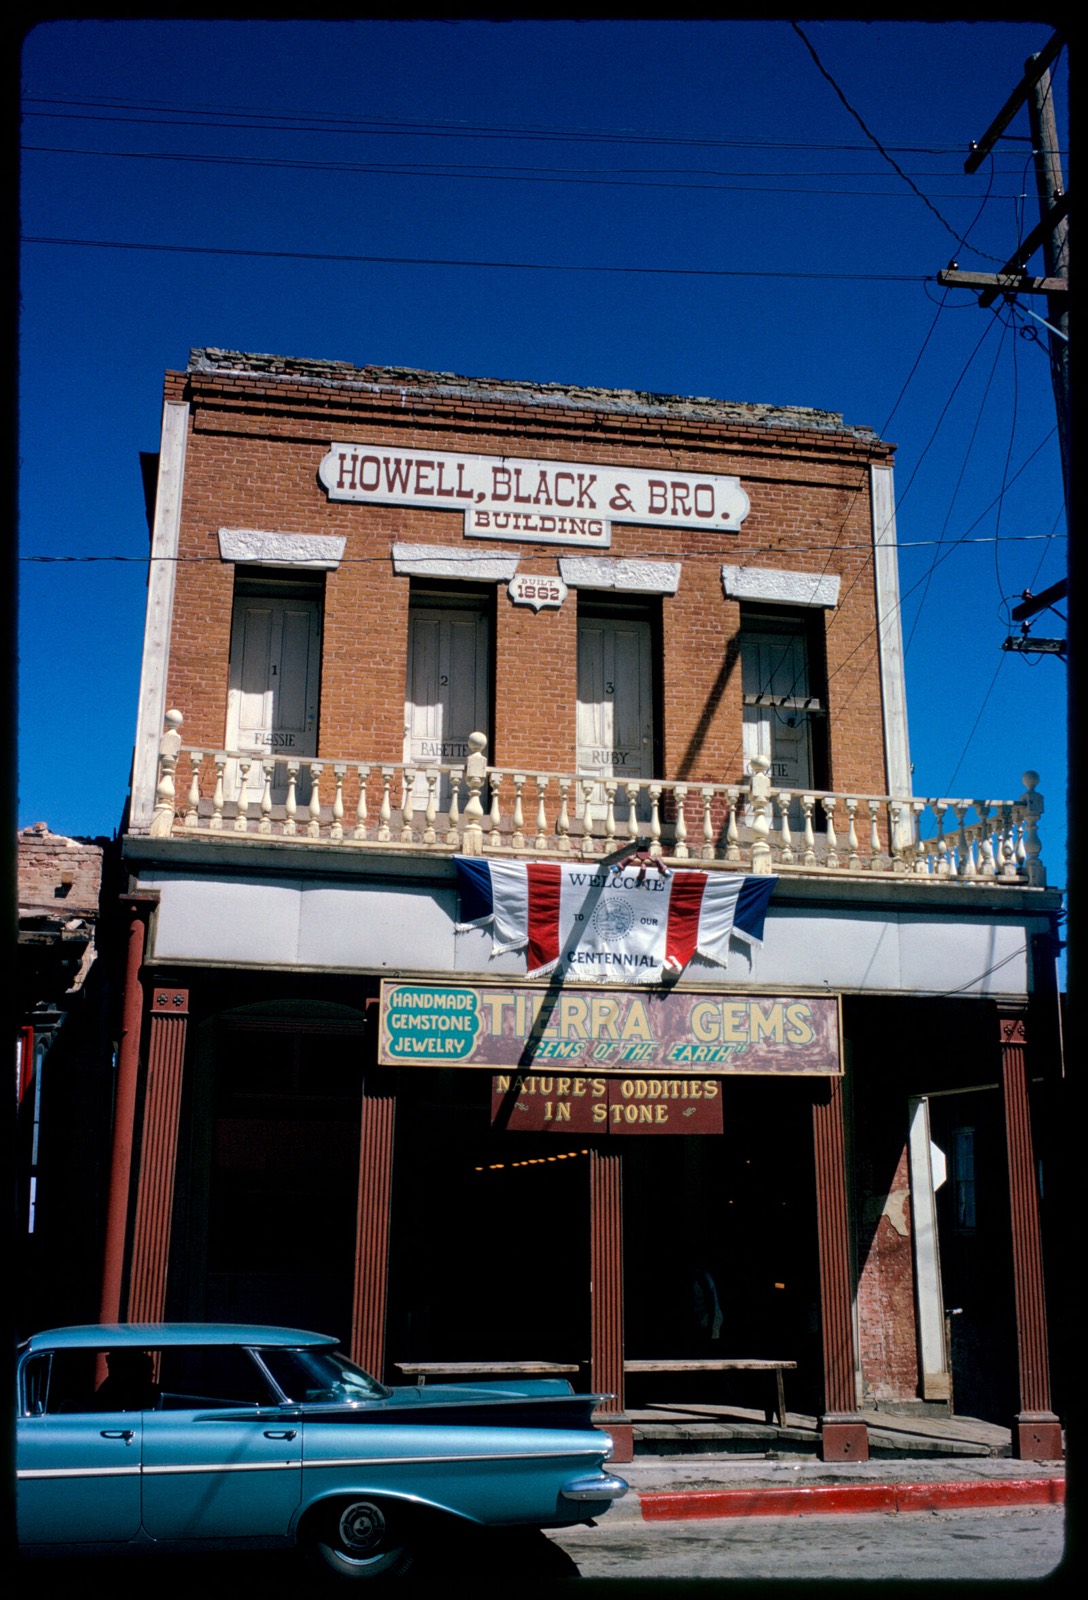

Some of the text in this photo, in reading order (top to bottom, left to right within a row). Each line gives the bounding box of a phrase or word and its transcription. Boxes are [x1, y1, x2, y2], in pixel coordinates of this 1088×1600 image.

[336, 453, 731, 520] HOWELL, BLACK & BRO.
[475, 510, 603, 537] BUILDING
[521, 578, 555, 587] BUILT
[518, 585, 560, 601] 1862
[271, 665, 278, 676] 1
[440, 676, 448, 686] 2
[605, 682, 615, 694] 3
[421, 742, 468, 757] BABETTE
[592, 751, 630, 765] RUBY
[574, 913, 584, 922] TO
[640, 918, 658, 926] OUR
[567, 951, 658, 968] CENTENNIAL
[392, 993, 474, 1011] HANDMADE
[391, 1014, 472, 1031] GEMSTONE
[484, 994, 814, 1044] TIERRA GEMS
[394, 1037, 465, 1053] JEWELRY
[592, 1042, 615, 1059] OF
[620, 1043, 656, 1060] THE
[496, 1076, 718, 1099] NATURE'S ODDITIES
[544, 1102, 669, 1123] IN STONE
